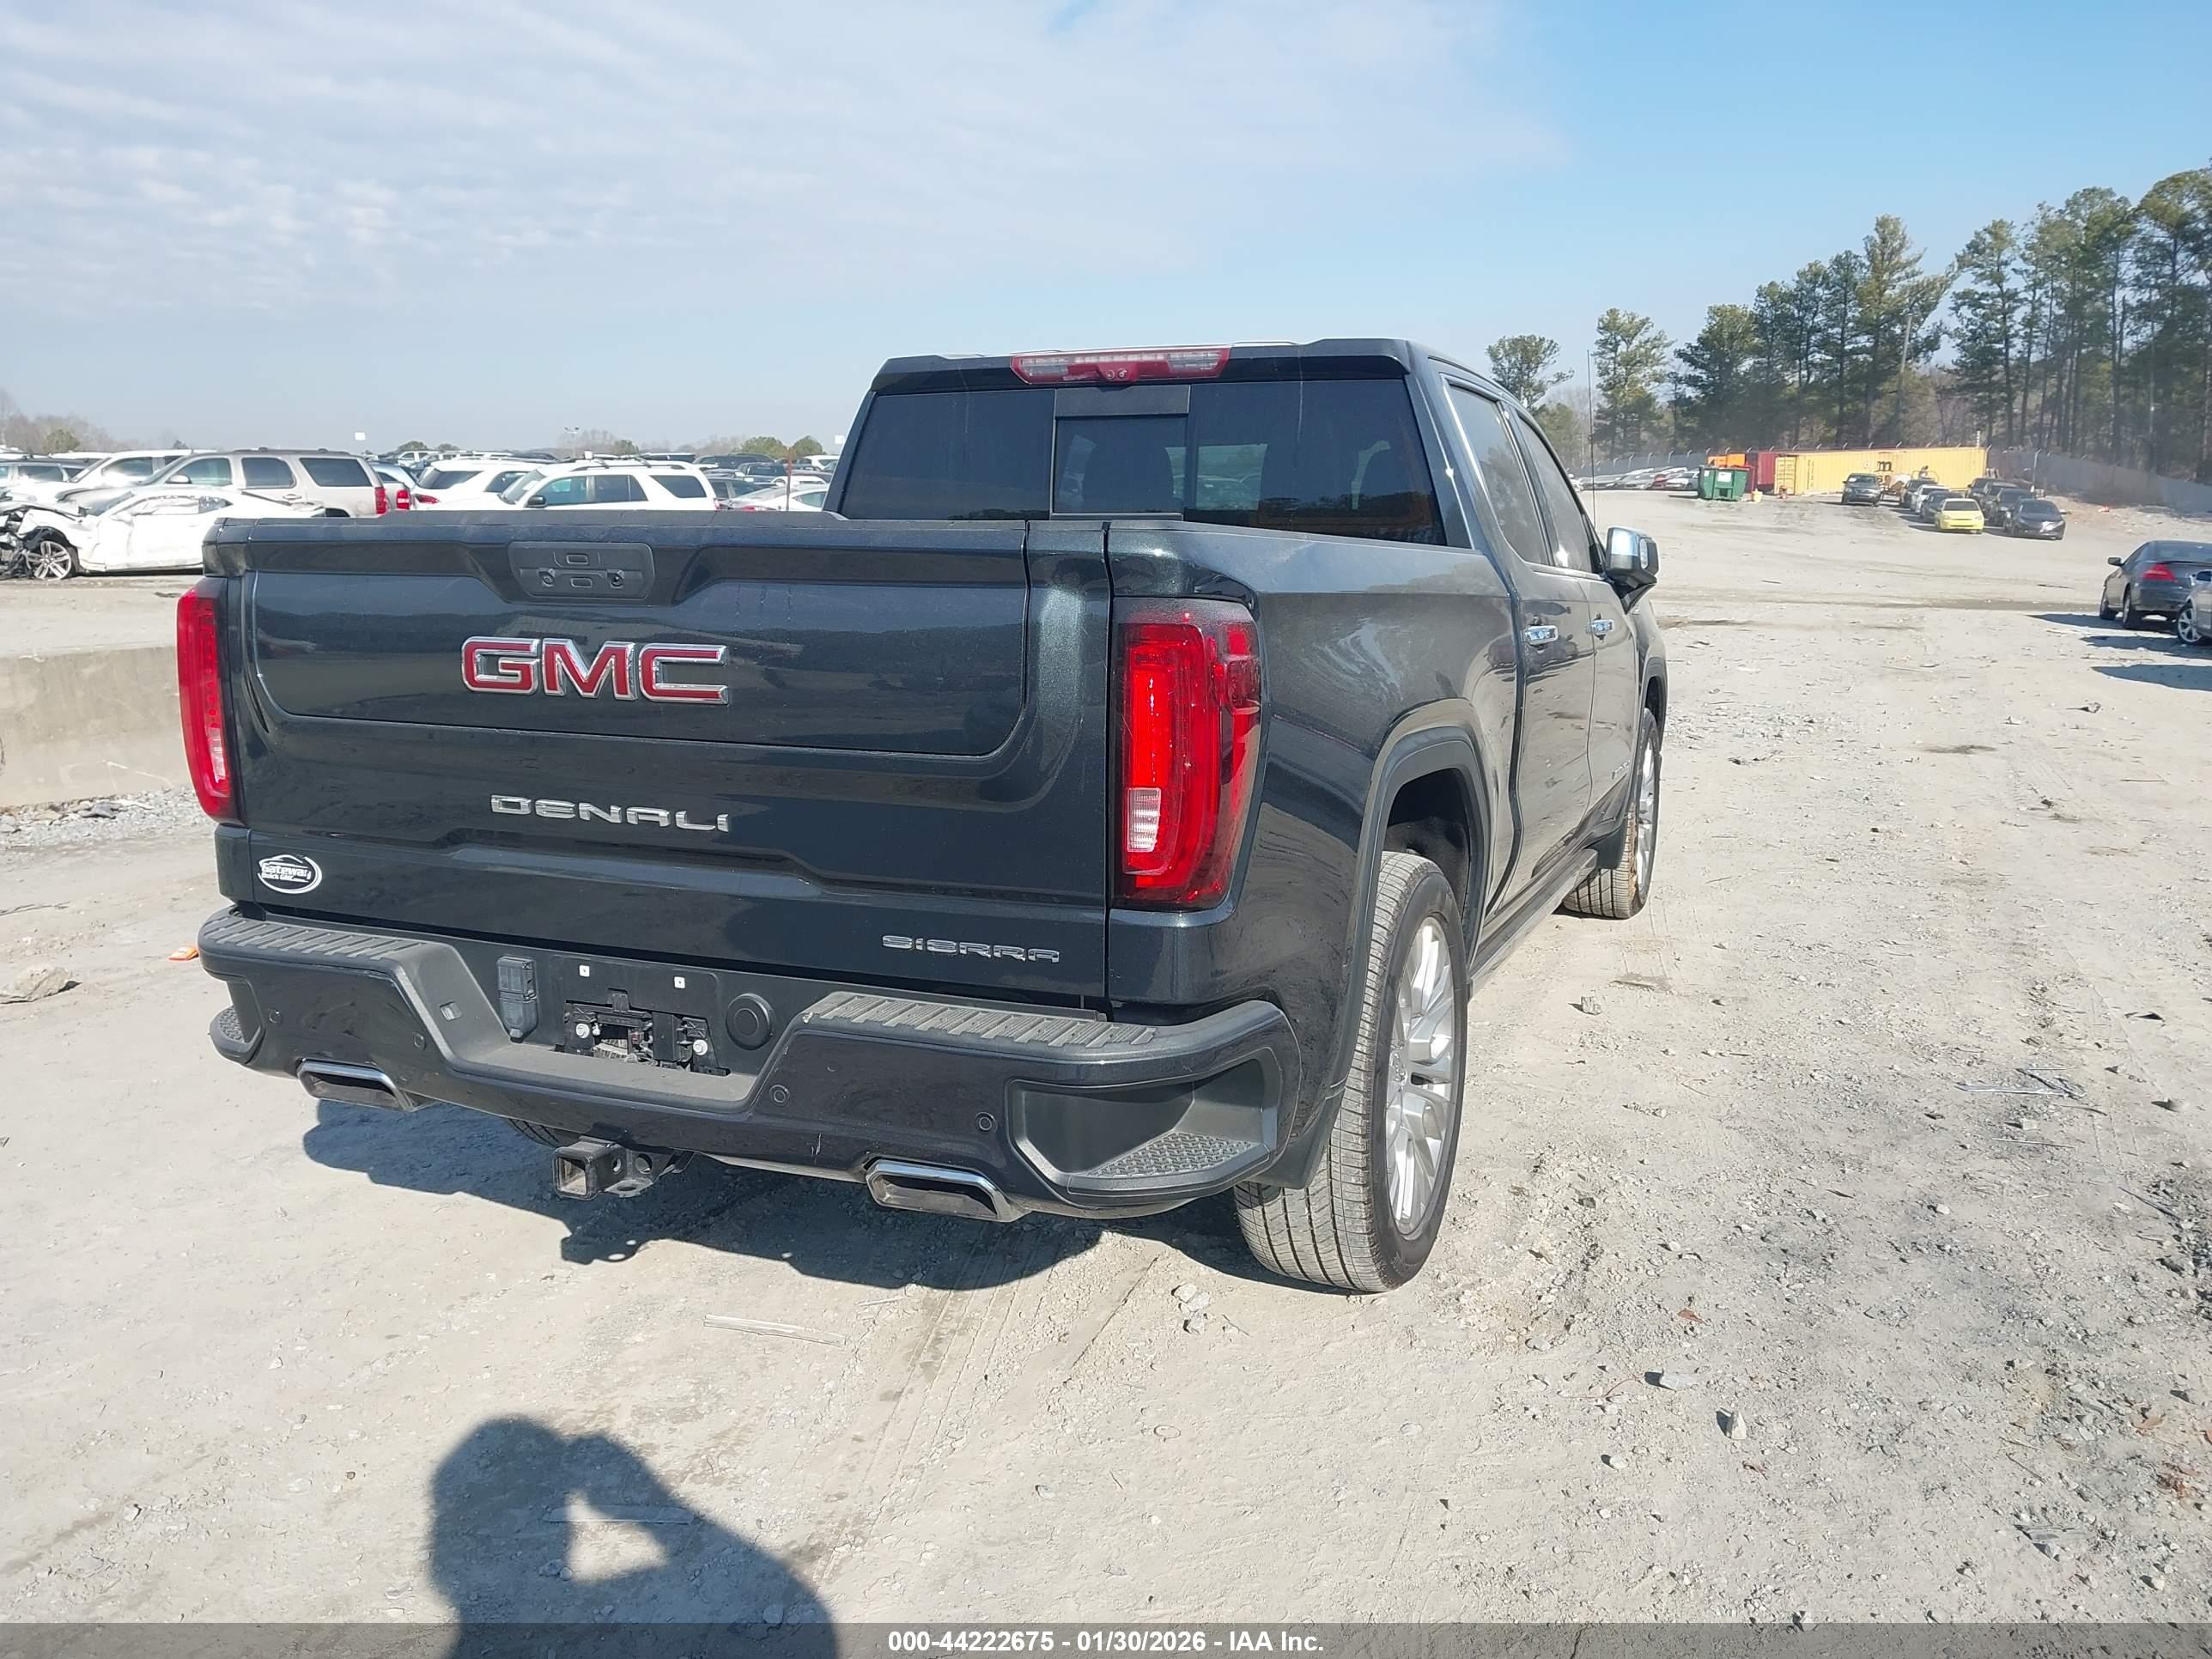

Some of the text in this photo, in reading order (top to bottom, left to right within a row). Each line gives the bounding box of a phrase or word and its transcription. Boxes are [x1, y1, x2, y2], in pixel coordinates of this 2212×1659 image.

[462, 636, 730, 706] GMC
[491, 795, 729, 833] DENALI
[882, 935, 1060, 963] SIERRA
